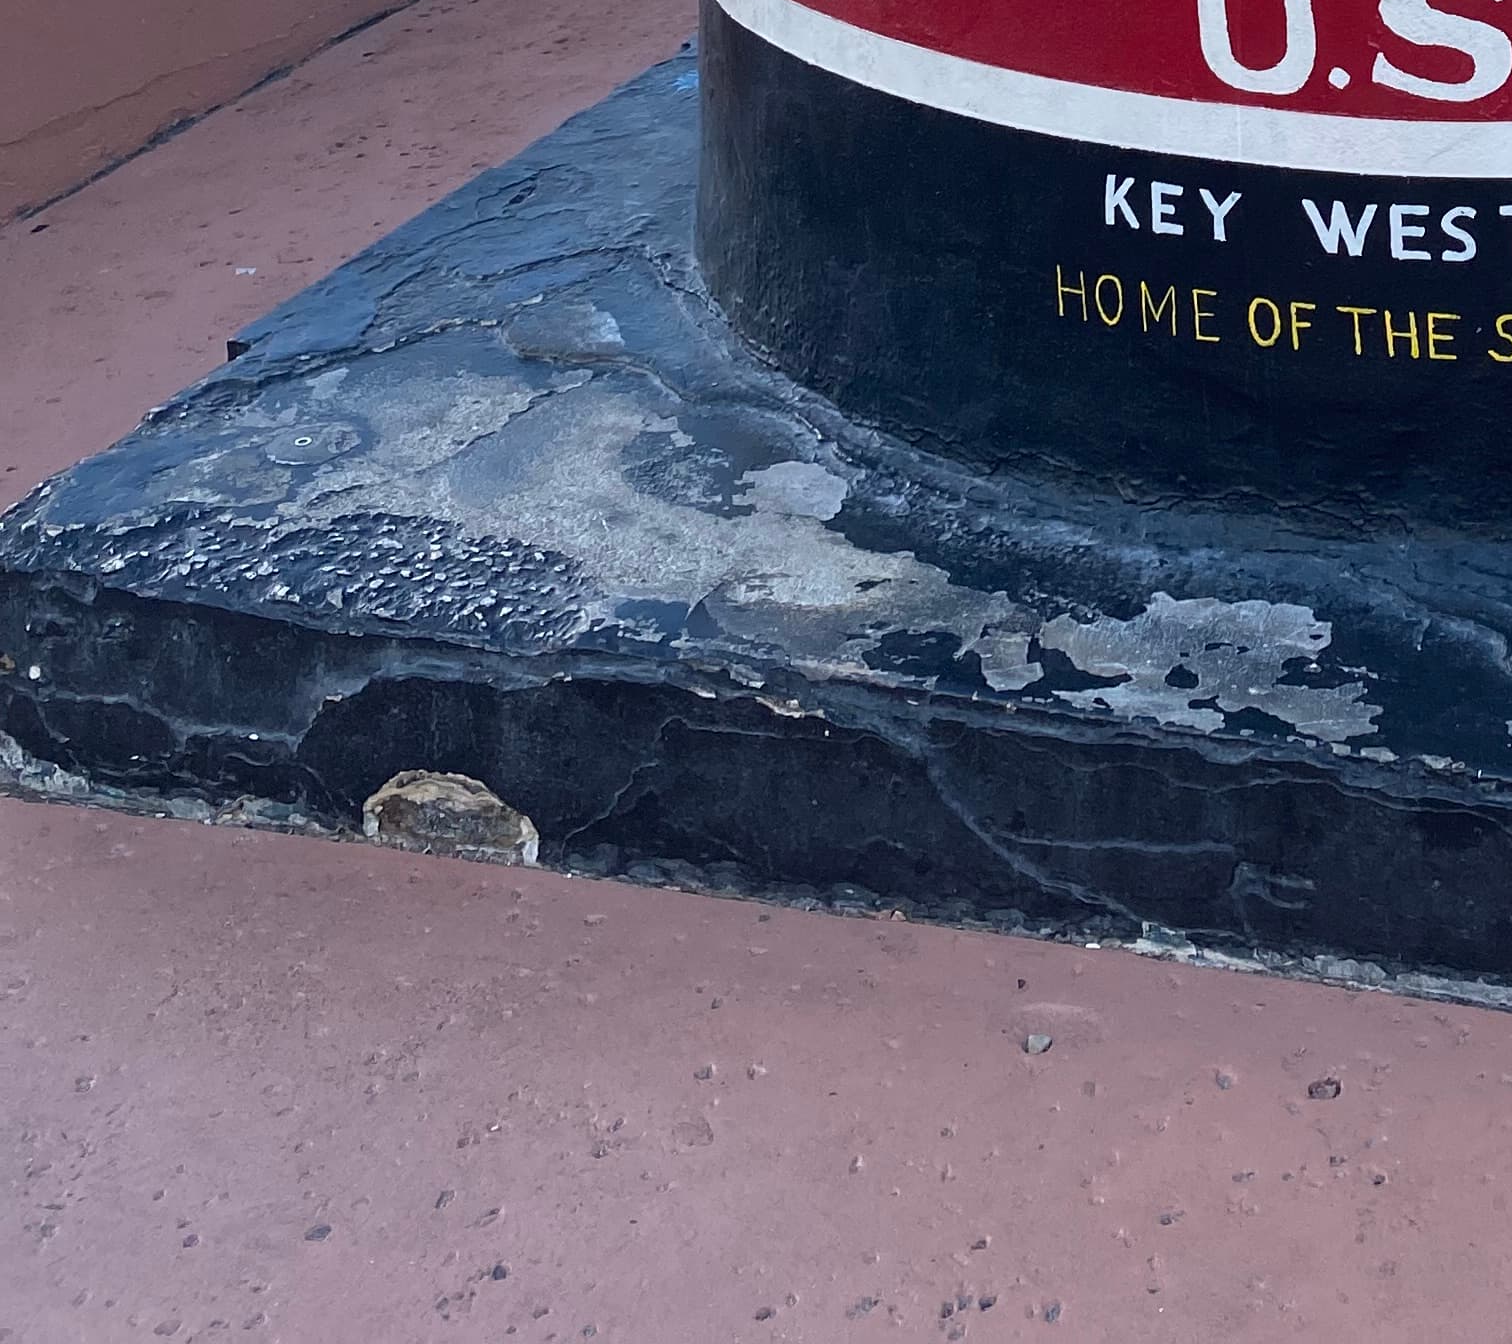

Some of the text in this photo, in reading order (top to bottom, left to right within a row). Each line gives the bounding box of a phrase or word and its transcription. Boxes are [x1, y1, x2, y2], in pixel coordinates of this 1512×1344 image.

[1104, 173, 1244, 243] KEY
[1054, 264, 1220, 344] HOME
[1248, 296, 1316, 351] OF
[1337, 304, 1460, 361] THE
